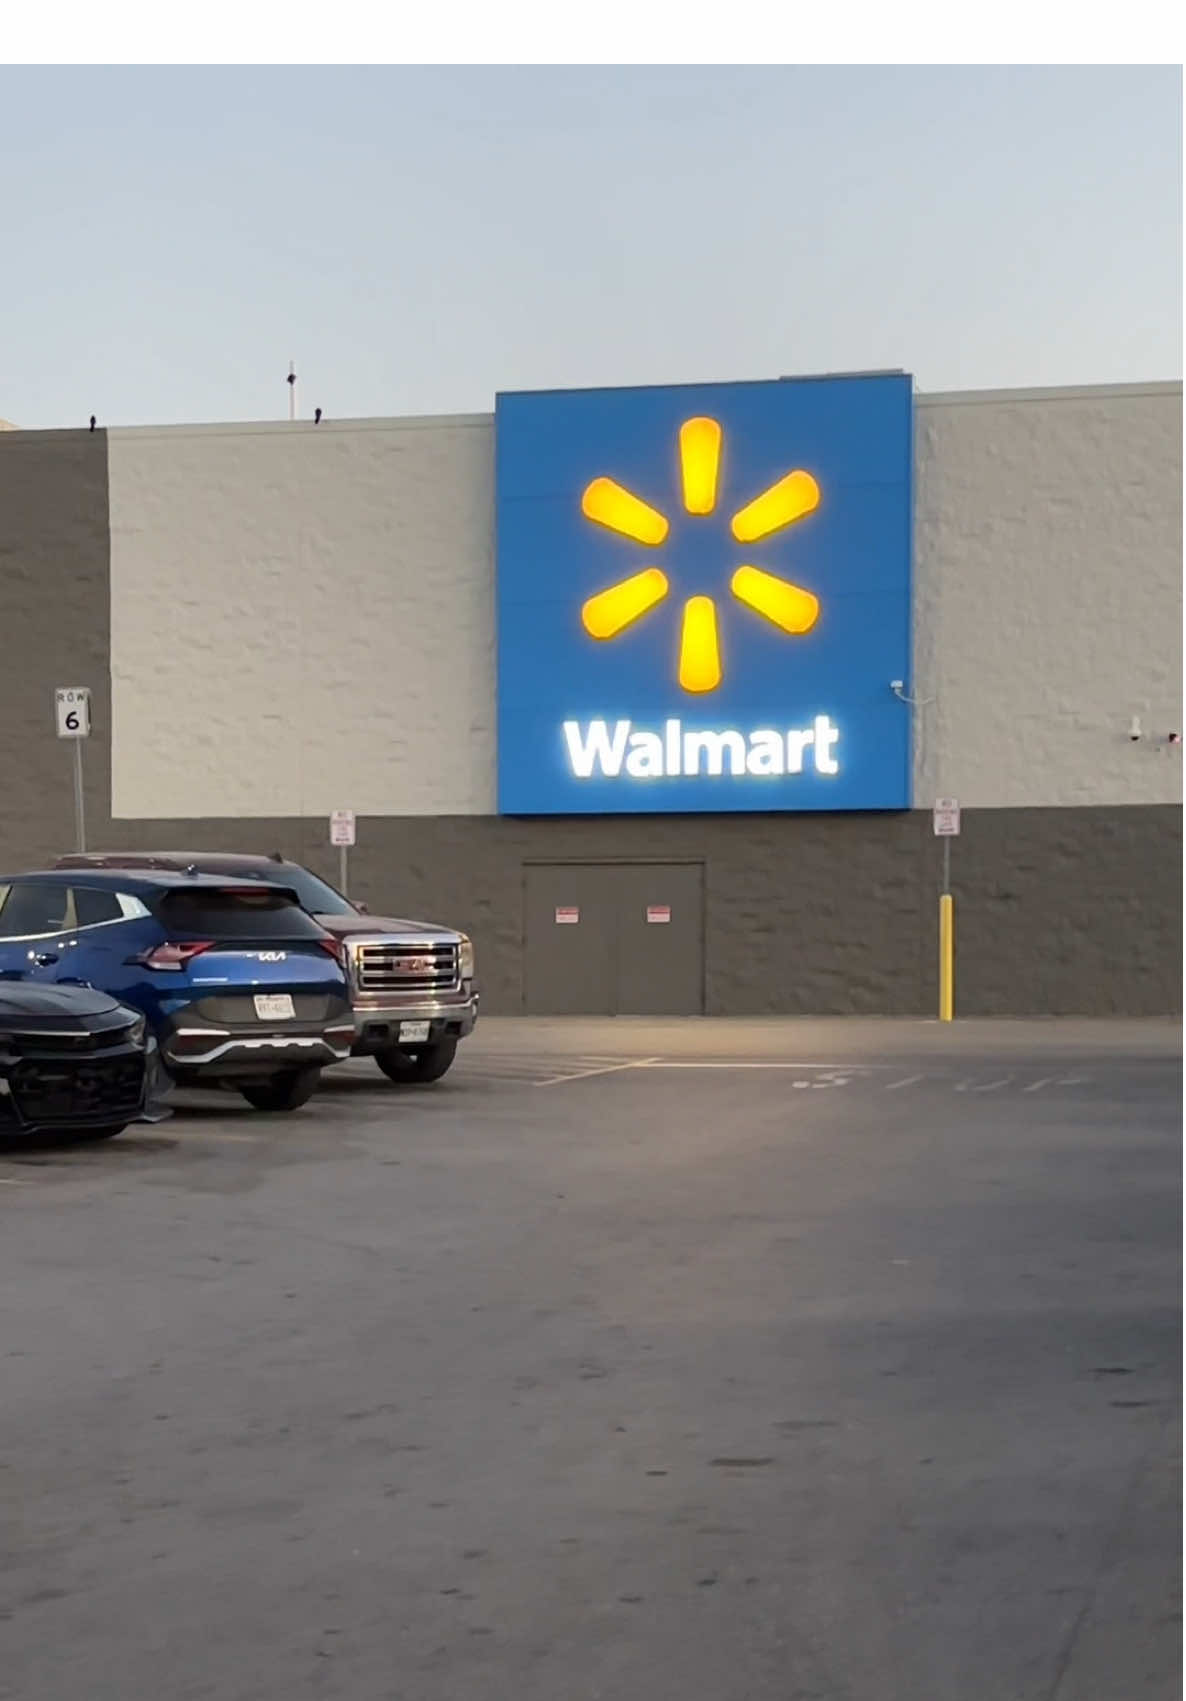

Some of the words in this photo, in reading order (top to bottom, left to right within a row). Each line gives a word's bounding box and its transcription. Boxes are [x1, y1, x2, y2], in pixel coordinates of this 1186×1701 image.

[56, 692, 87, 704] ROW
[66, 711, 79, 730] 6
[563, 715, 839, 777] Walmart
[259, 951, 286, 961] KIA
